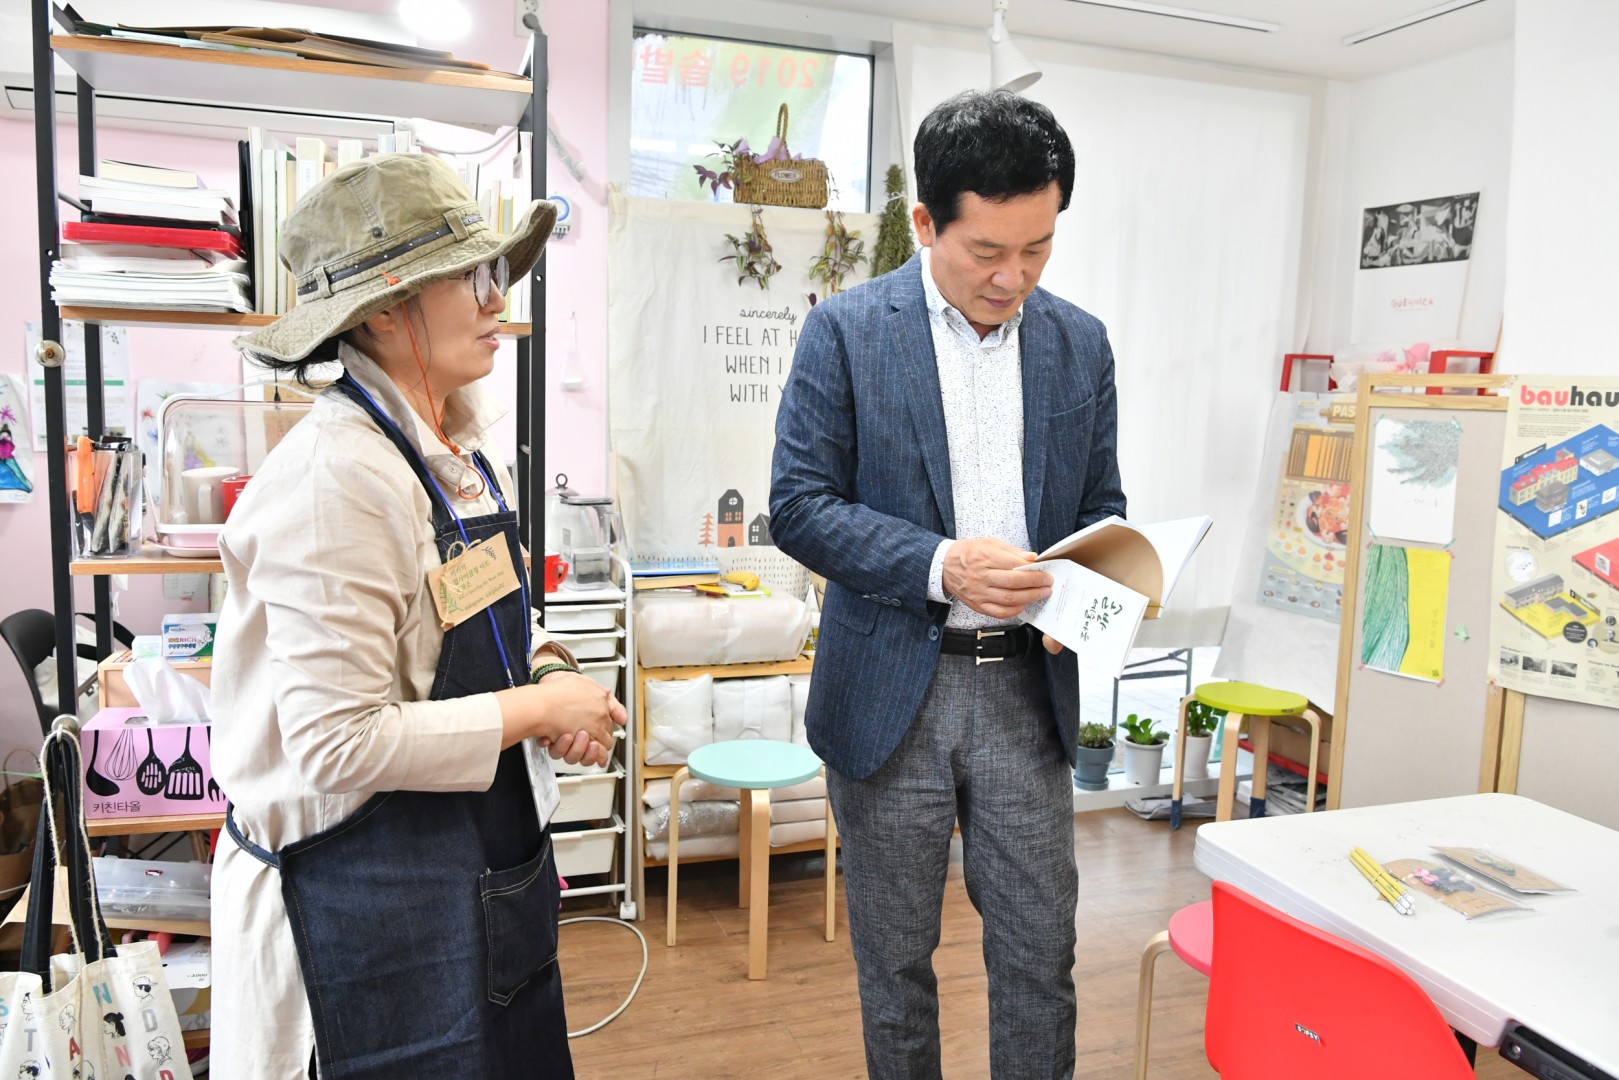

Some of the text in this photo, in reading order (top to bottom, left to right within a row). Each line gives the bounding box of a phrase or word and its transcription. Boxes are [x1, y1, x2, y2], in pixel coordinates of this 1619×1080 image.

[773, 171, 798, 180] FLOWER
[739, 306, 797, 326] sincerely
[703, 325, 707, 344] I
[716, 325, 753, 346] FEEL
[761, 328, 781, 347] AT
[725, 355, 782, 375] WHEN I
[730, 384, 768, 403] WITH
[93, 800, 141, 814] 키친타올
[24, 1028, 37, 1052] T
